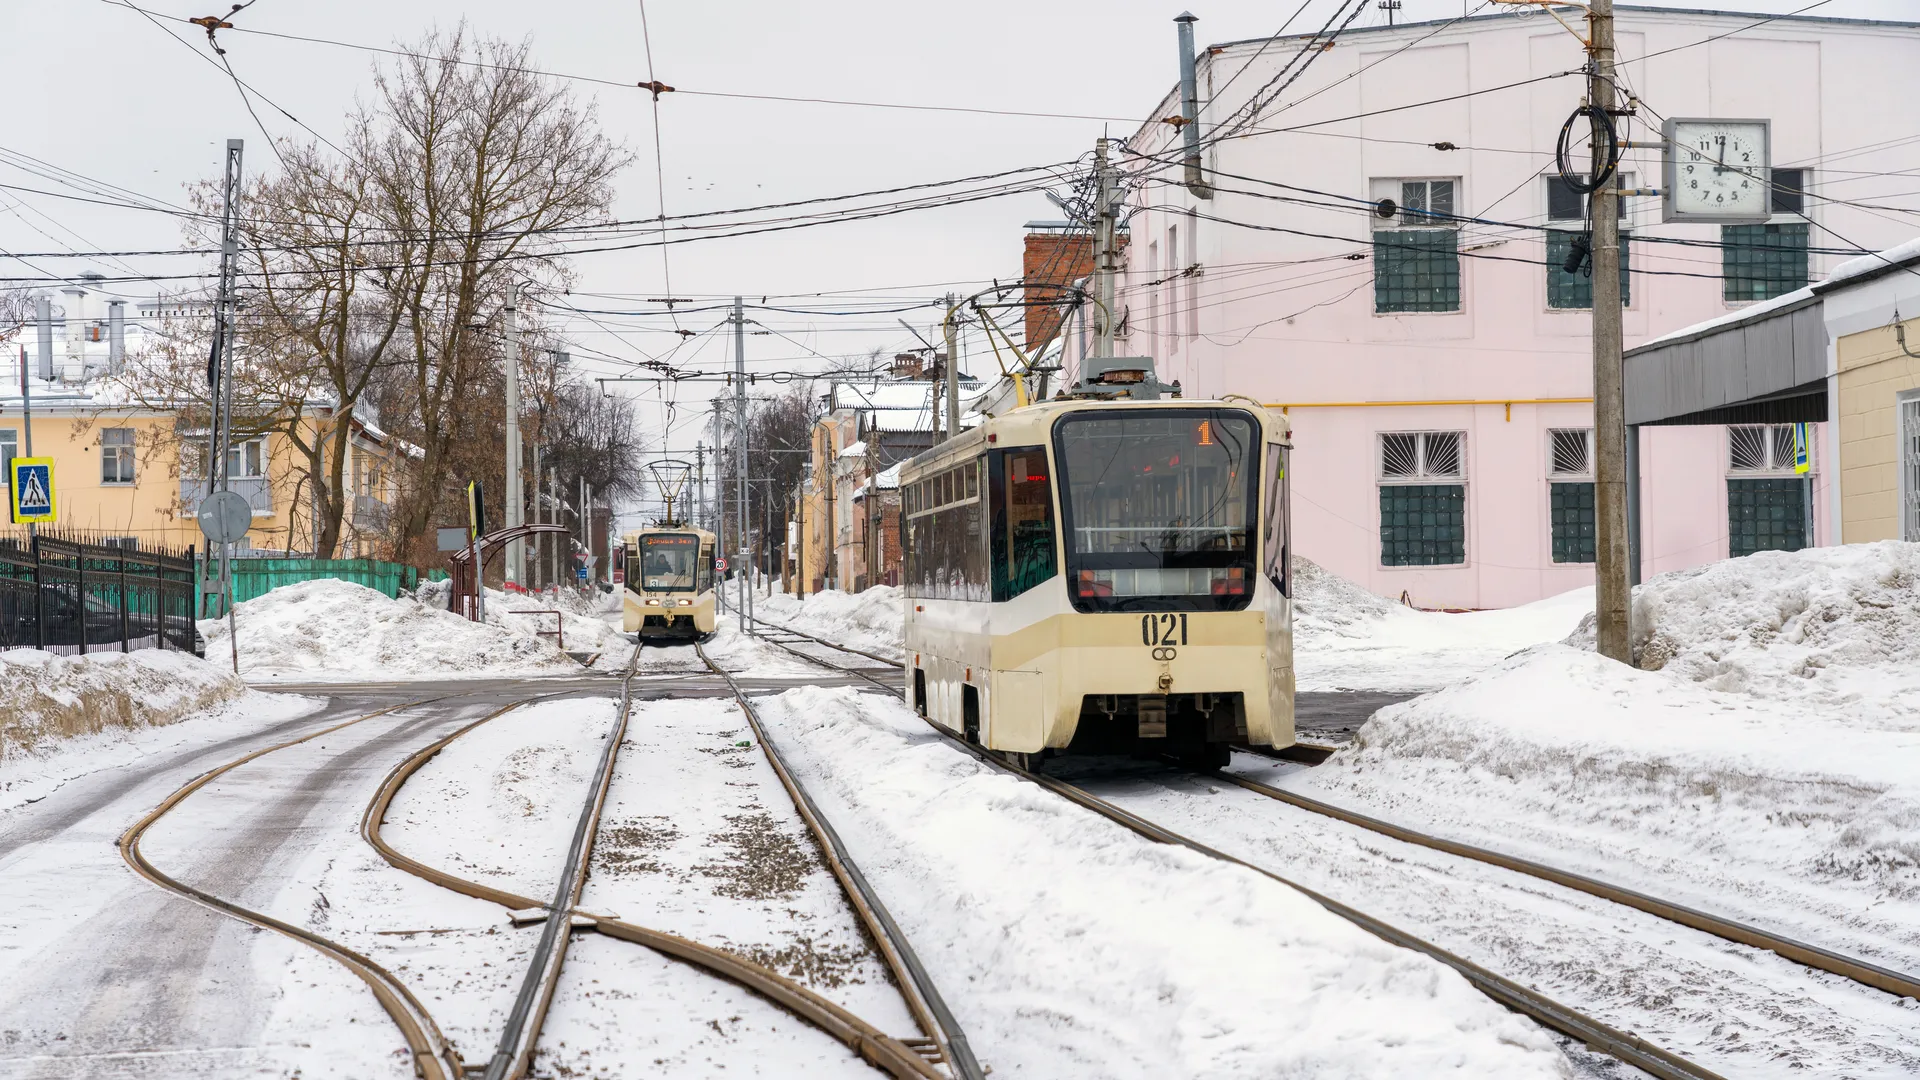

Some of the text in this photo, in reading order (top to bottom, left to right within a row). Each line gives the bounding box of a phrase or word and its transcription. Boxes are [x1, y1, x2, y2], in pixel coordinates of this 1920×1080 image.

[1714, 136, 1726, 145] 12
[1700, 141, 1710, 150] 11
[1734, 142, 1738, 151] 1
[1690, 152, 1701, 161] 10
[1742, 152, 1750, 162] 2
[1686, 165, 1694, 174] 9
[1746, 166, 1753, 175] 3
[1691, 180, 1698, 189] 8
[1741, 180, 1748, 189] 4
[1703, 191, 1710, 200] 7
[1716, 194, 1723, 202] 6
[1732, 191, 1738, 200] 5
[1198, 420, 1213, 445] 1
[1142, 614, 1187, 646] 021
